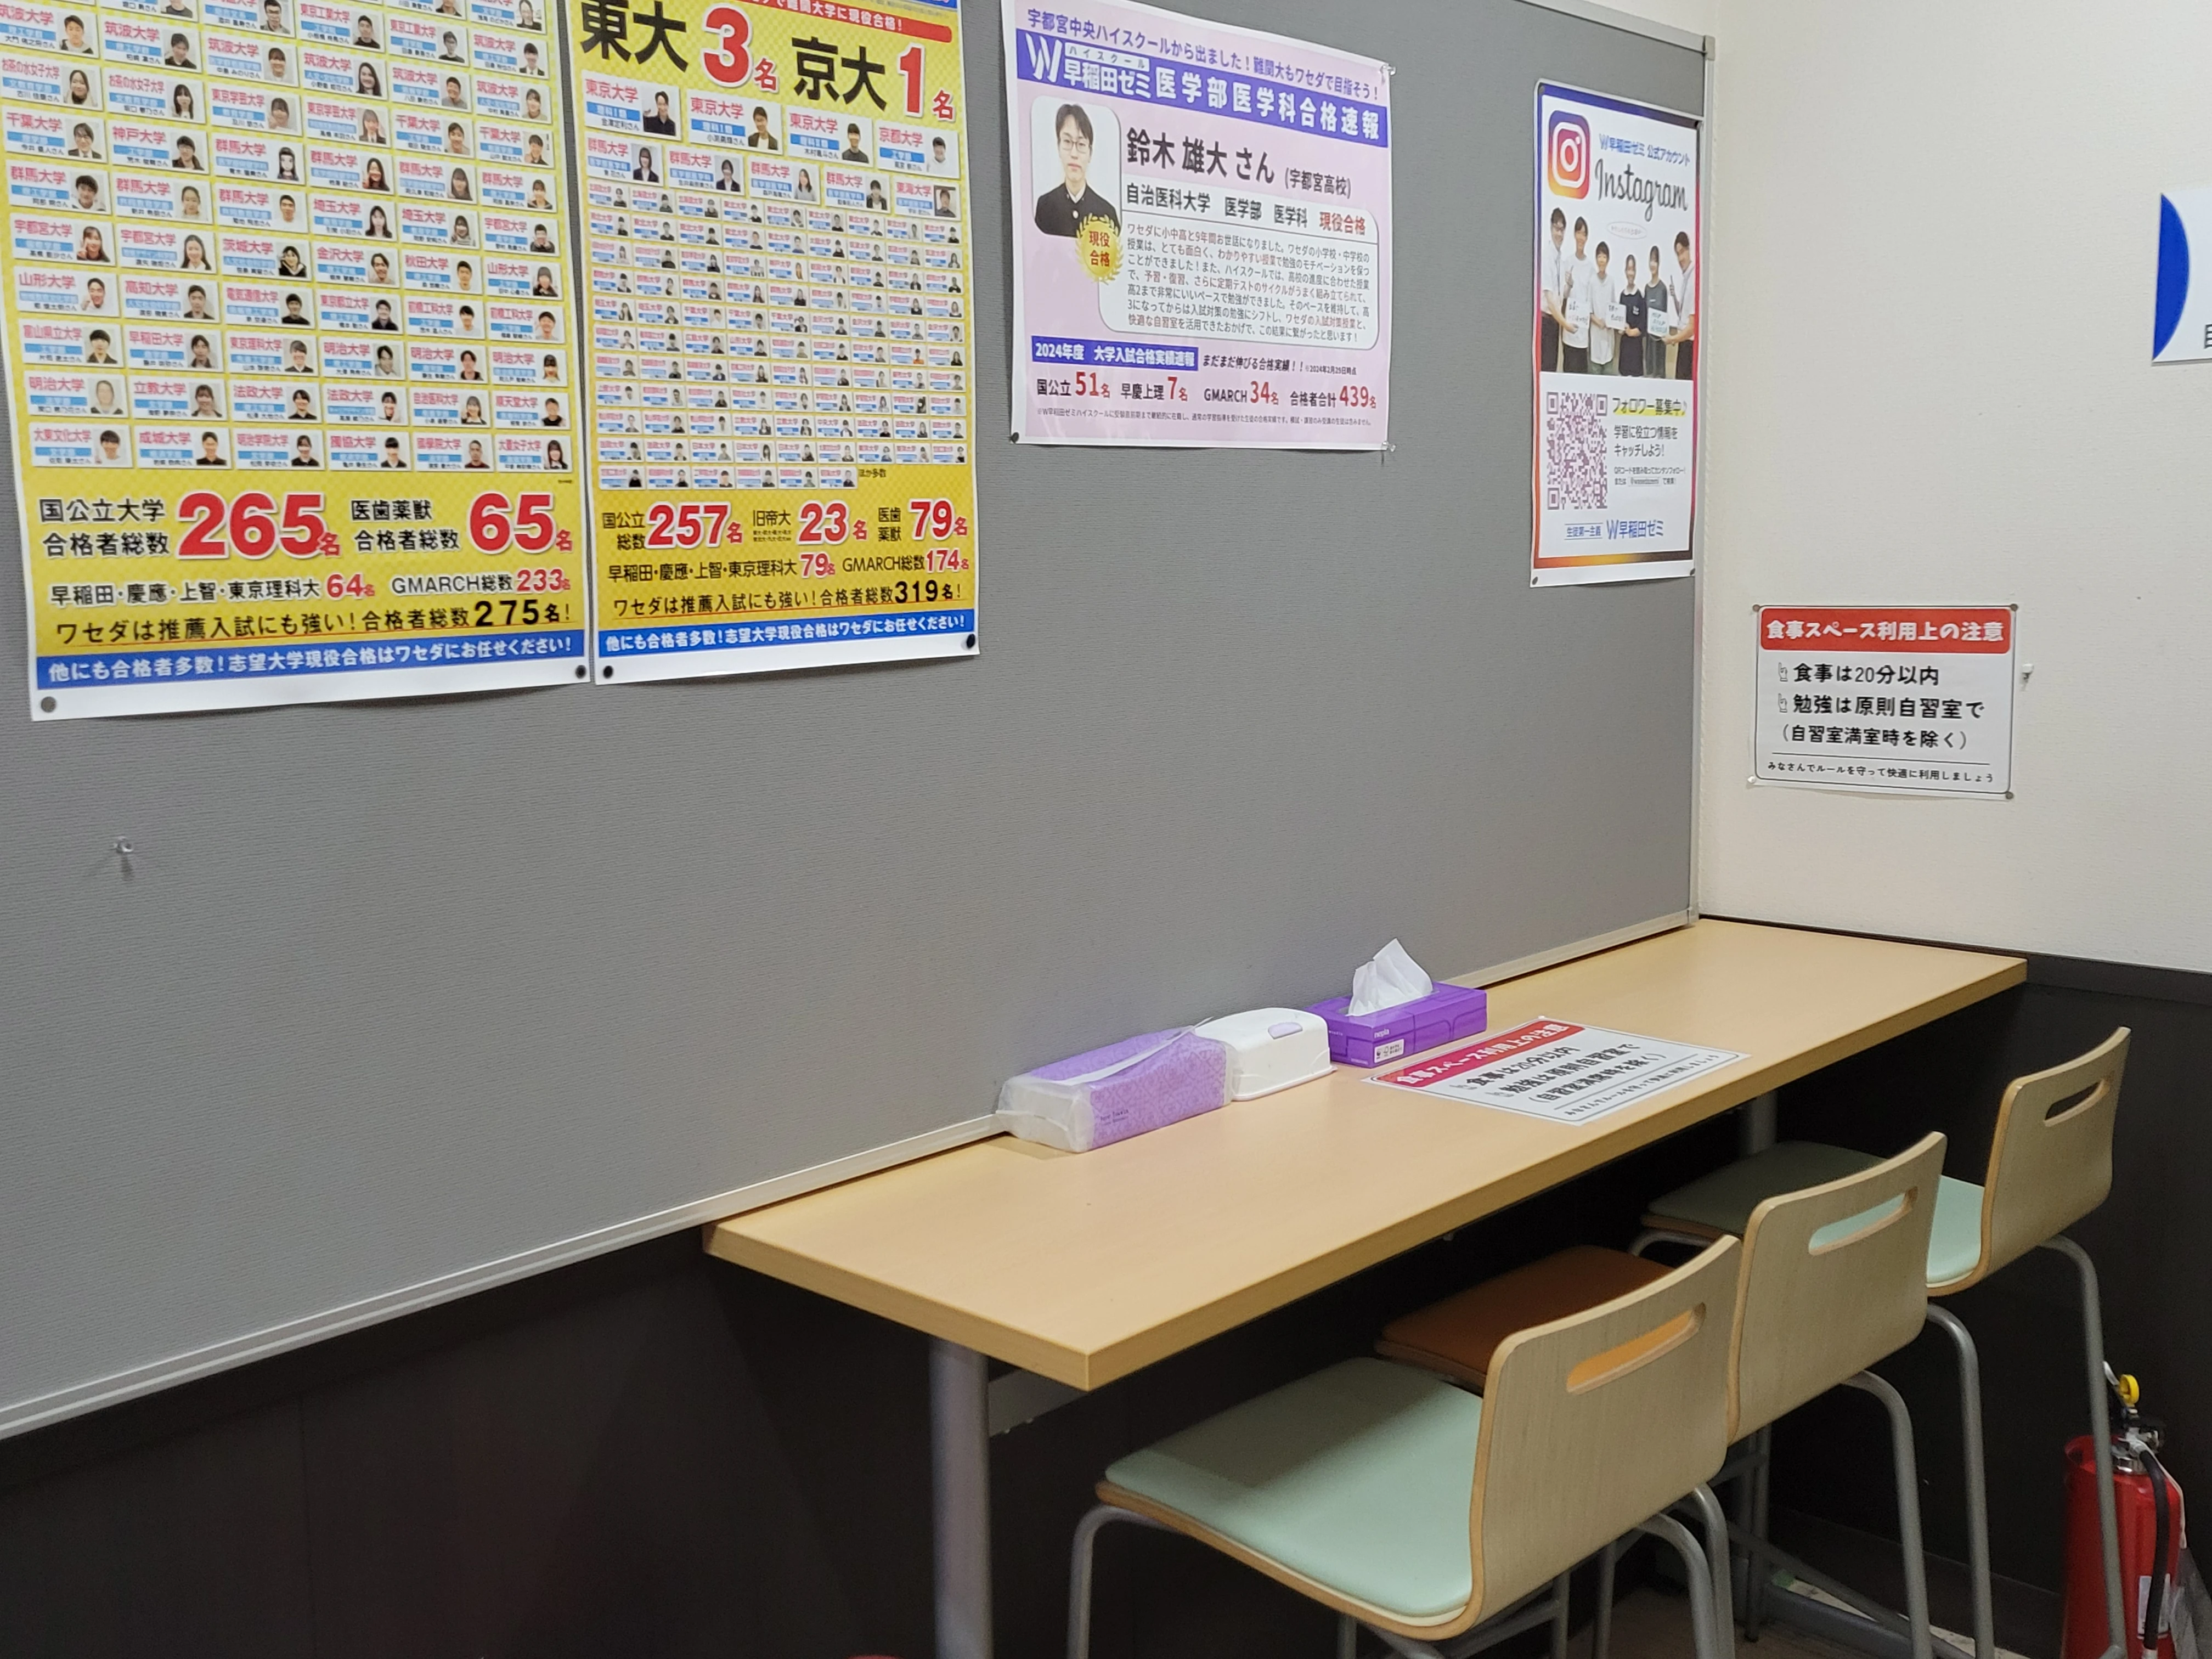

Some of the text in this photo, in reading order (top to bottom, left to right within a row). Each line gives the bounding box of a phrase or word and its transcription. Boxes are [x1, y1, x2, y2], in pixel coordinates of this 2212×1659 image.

[301, 3, 350, 23] 東京工業大学
[105, 21, 160, 42] 筑波大学
[208, 37, 259, 57] 筑波大学
[473, 34, 516, 53] 筑波大学
[304, 52, 352, 72] 筑波大学
[580, 0, 955, 121] 東大 3名 京大 1名
[1028, 8, 1378, 101] 宇都宮中央ハイスクールから出ました！難関大もワセダで目指そう！
[1069, 46, 1147, 69] ハイスクール
[2, 58, 60, 80] お茶の水女子大学
[109, 75, 165, 95] お茶の水女子大学
[585, 78, 639, 103] 東京大学
[691, 97, 744, 119] 東京大学
[1156, 66, 1379, 140] 医学部医学科合格速報
[6, 112, 63, 132] 千葉大学
[396, 114, 441, 132] 千葉大学
[789, 113, 838, 134] 東京大学
[112, 126, 166, 145] 神戸大学
[479, 127, 521, 143] 千葉大学
[879, 127, 923, 148] 京都大学
[215, 138, 267, 157] 群馬大学
[588, 137, 628, 156] 群馬大学
[1127, 126, 1175, 170] 鈴木
[1182, 136, 1227, 177] 雄大
[1235, 147, 1275, 184] さん
[1647, 144, 1691, 167] 公式アカウント
[311, 150, 358, 168] 群馬大学
[670, 151, 711, 168] 群馬大学
[10, 166, 66, 185] 群馬大学
[751, 161, 790, 178] 群馬大学
[116, 178, 171, 196] 群馬大学
[827, 172, 862, 188] 群馬大学
[1595, 158, 1688, 222] Instagram
[219, 189, 269, 206] 群馬大学
[314, 198, 361, 216] 埼玉大学
[1126, 183, 1365, 235] 自治医科大学 医学部 医学科 現役合格
[14, 219, 72, 237] 宇都宮大学
[121, 229, 176, 246] 宇都宮大学
[223, 238, 274, 255] 茨城大学
[1089, 230, 1110, 247] 現役
[317, 246, 364, 262] 金沢大学
[1090, 249, 1110, 267] 合格
[488, 262, 529, 276] 山形大学
[20, 270, 75, 289] 山形大学
[125, 279, 178, 297] 高知大学
[129, 331, 183, 346] 早稲田大学
[324, 342, 370, 356] 明治大学
[1035, 342, 1085, 360] 2024年度
[1093, 346, 1195, 366] 大学入試合格実績速報
[29, 376, 84, 392] 明治大学
[134, 381, 187, 396] 立教大学
[234, 386, 284, 399] 法政大学
[1037, 371, 1376, 409] 国公立 51名 早慶上理 7名 GMARCH 34名 合格者合計 439名
[1614, 425, 1678, 440] 学習に役立つ情報を
[40, 499, 165, 522] 国公立大学
[352, 499, 432, 520] 医歯薬獣
[878, 507, 901, 523] 医歯
[42, 493, 340, 558] 合格者総数 265名
[354, 493, 573, 552] 合格者総数 65名
[603, 512, 644, 529] 国公立
[617, 504, 742, 549] 総数 257名
[753, 503, 867, 542] 旧帝大 23名
[878, 500, 967, 542] 薬獣 79名
[800, 552, 836, 577] 79名
[327, 574, 375, 597] 64名
[606, 615, 965, 652] 他にも合格者多数！志望大学現役合格はワセダにお任せください！
[1767, 619, 2004, 642] 食事スペース利用上の注意
[49, 637, 571, 682] 他にも合格者多数！志望大学現役合格はワセダにお任せください！
[1793, 663, 1939, 685] 食事は20分以内
[1793, 693, 1985, 719] 勉強は原則自習室で
[1767, 761, 1994, 783] みなさんでルールを守って快適に利用しましょう
[1397, 1024, 1569, 1083] 食事スペース利用上の注意
[1467, 1047, 1581, 1086] 食事は20分以内
[1499, 1043, 1640, 1093] 勉強は原則自習室で
